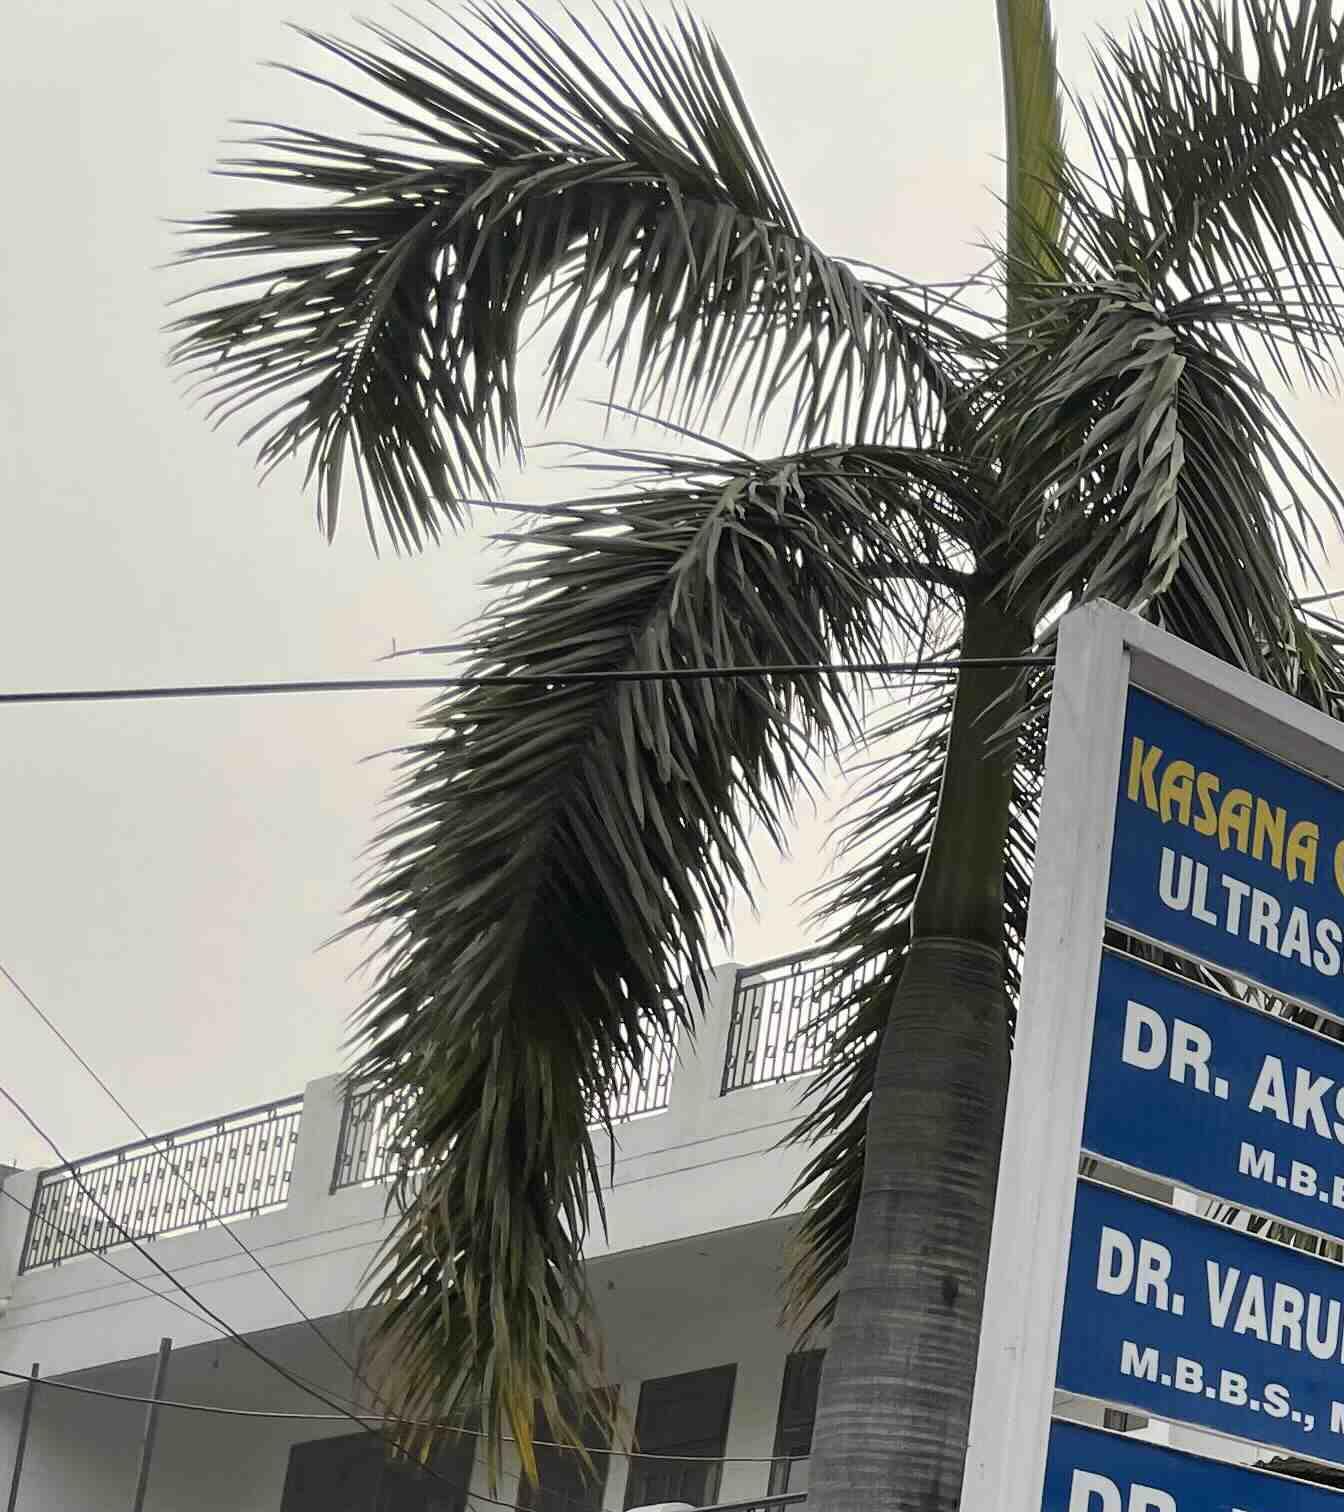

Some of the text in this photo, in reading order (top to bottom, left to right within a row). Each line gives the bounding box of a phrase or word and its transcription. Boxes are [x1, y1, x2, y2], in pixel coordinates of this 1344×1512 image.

[1127, 735, 1319, 885] KASANA
[1121, 999, 1230, 1101] DR.
[1095, 1225, 1186, 1317] DR.
[1119, 1339, 1316, 1433] M.B.B.S.,
